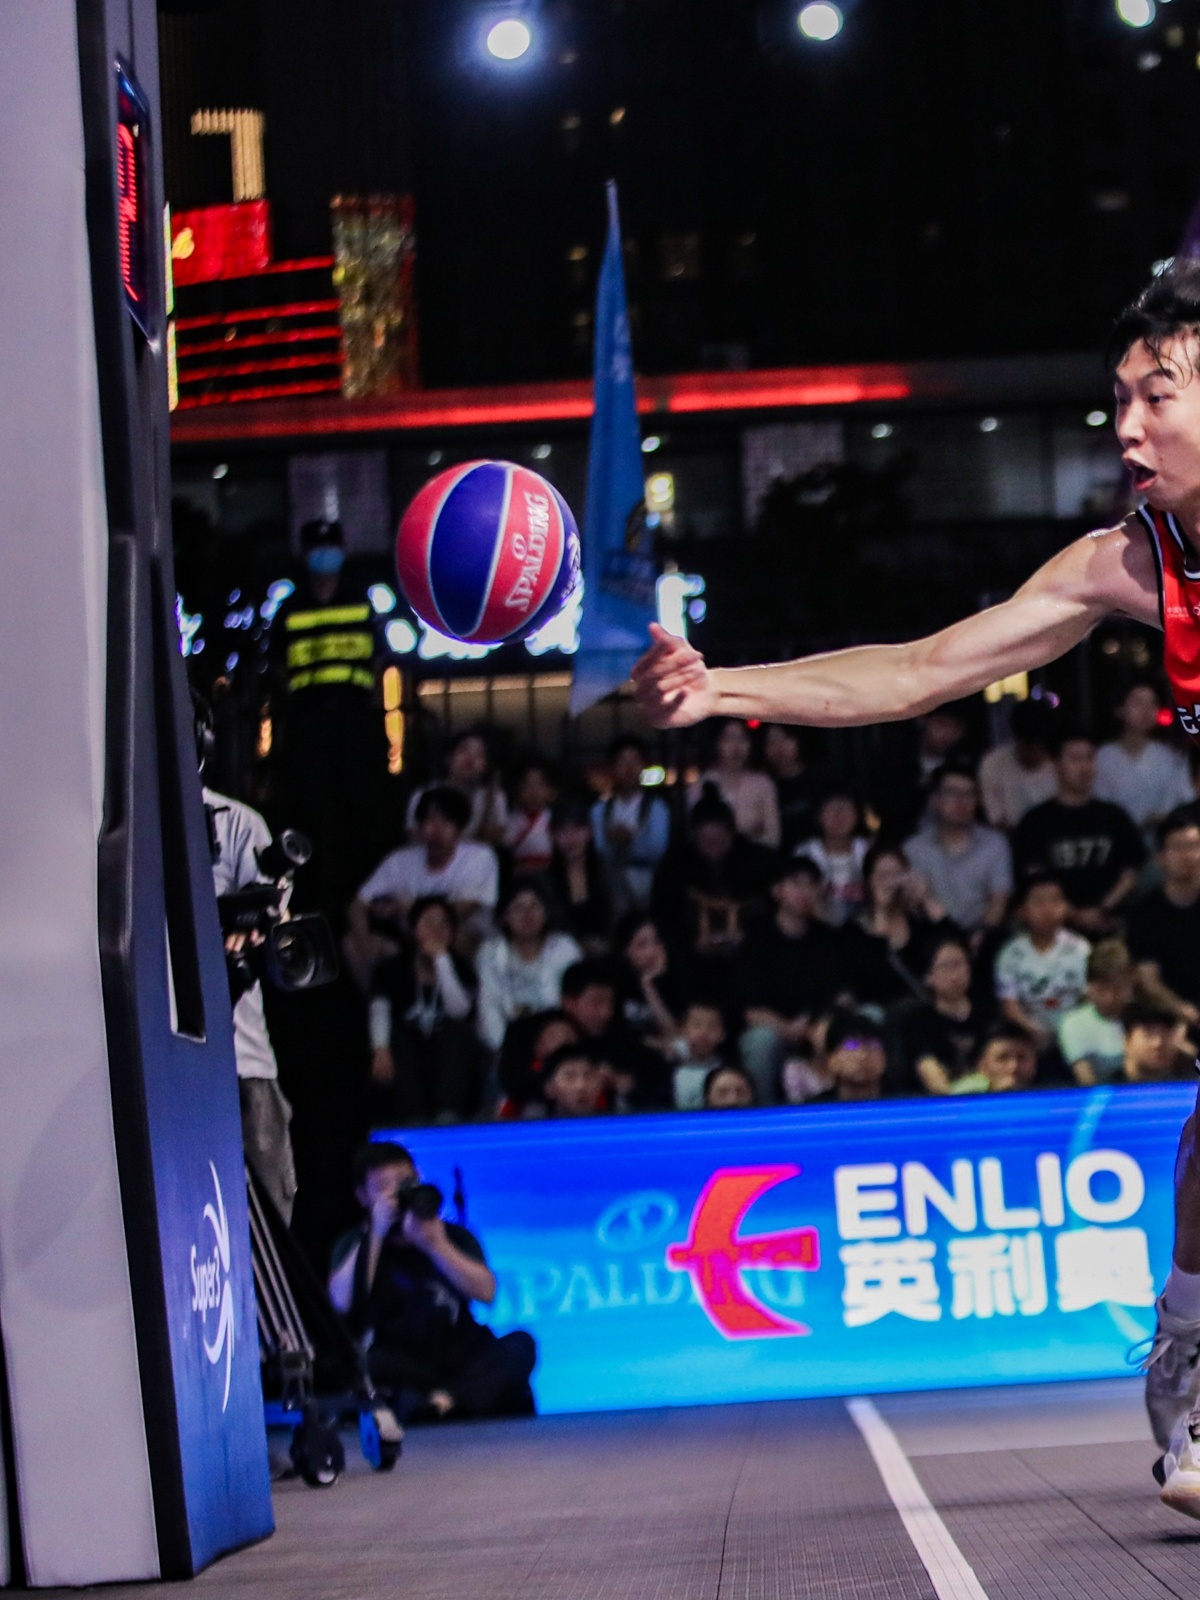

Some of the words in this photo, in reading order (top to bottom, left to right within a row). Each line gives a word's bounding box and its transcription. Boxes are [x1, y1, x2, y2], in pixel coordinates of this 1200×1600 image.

[505, 490, 549, 612] SPALDING
[834, 1148, 1146, 1241] ENLIO
[190, 1243, 221, 1323] Super3
[838, 1225, 1158, 1328] 英利奥
